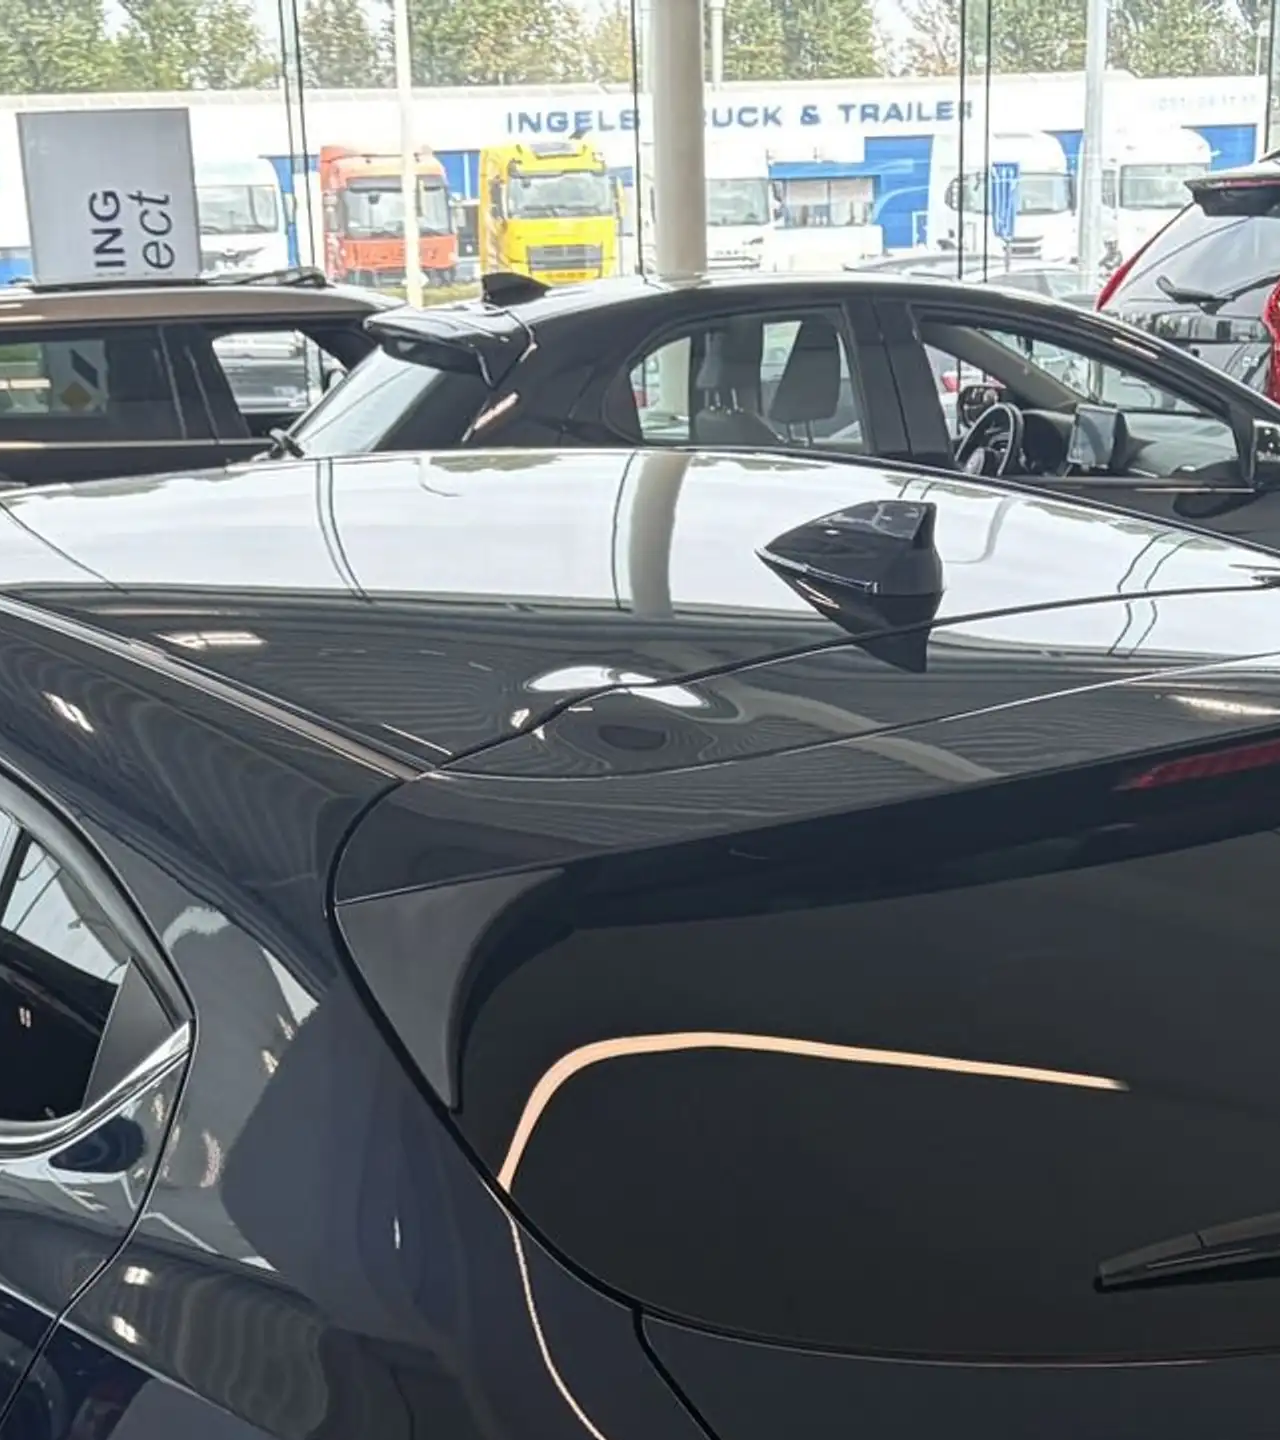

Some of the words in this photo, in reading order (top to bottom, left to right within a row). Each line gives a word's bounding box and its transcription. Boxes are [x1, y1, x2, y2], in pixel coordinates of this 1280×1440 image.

[506, 109, 641, 134] INGELS
[703, 106, 783, 128] UCK
[799, 104, 821, 126] &
[836, 100, 973, 124] TRAILER
[88, 190, 127, 276] ING
[127, 190, 176, 276] ect
